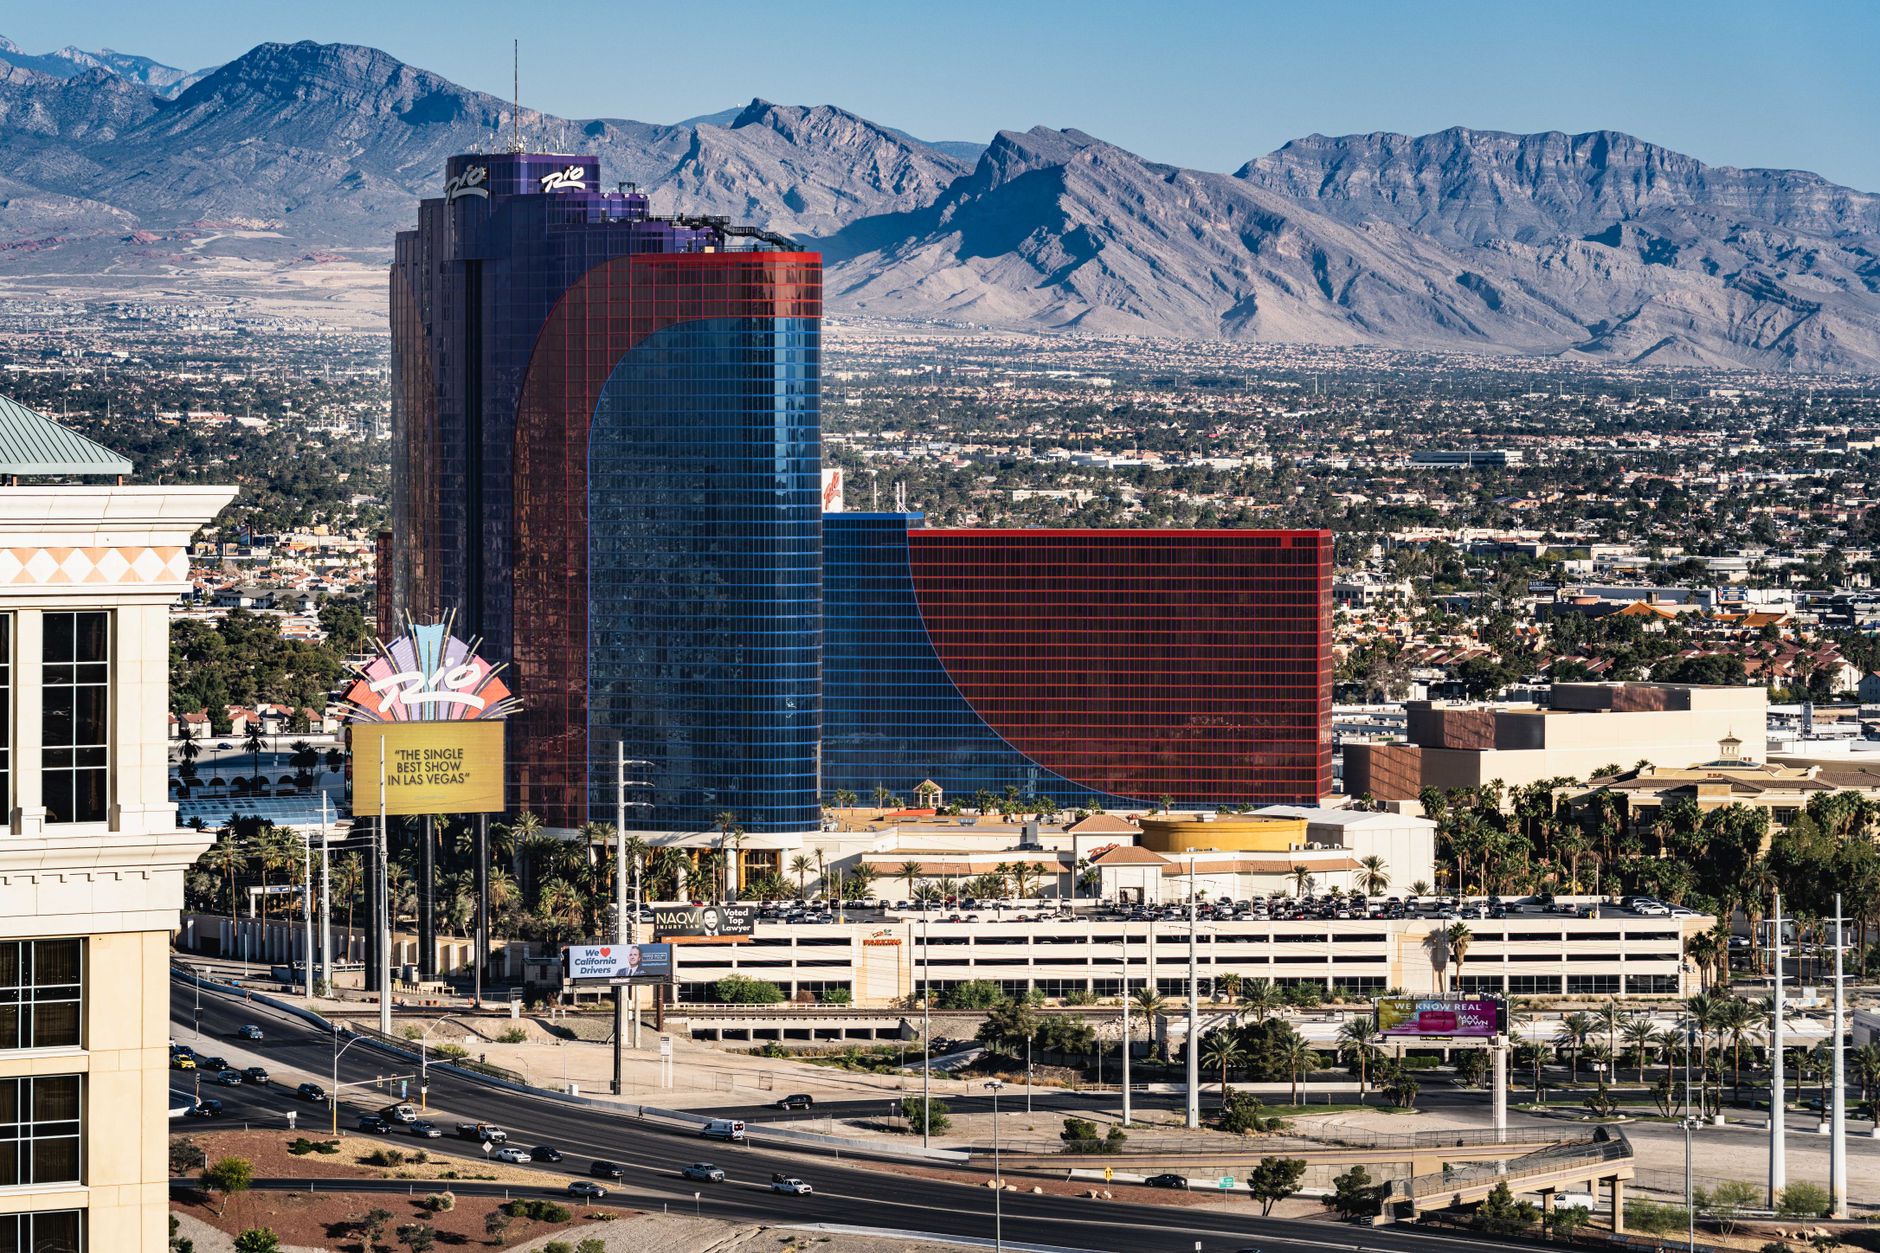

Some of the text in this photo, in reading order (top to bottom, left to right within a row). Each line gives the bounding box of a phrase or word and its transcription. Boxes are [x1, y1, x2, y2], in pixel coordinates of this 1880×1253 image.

[443, 164, 488, 205] Rio
[541, 165, 586, 193] Rio
[369, 656, 485, 712] Rio
[423, 748, 464, 760] SINGLE
[396, 761, 461, 773] BEST SHOW
[388, 774, 400, 786] IN
[404, 774, 423, 785] LAS
[656, 911, 701, 925] NAQVI
[723, 908, 749, 917] Voted
[728, 916, 744, 926] Top
[722, 924, 751, 933] Lawyer
[585, 949, 600, 957] We
[575, 956, 617, 966] California
[580, 966, 611, 975] Drivers
[1454, 1003, 1482, 1011] REAL
